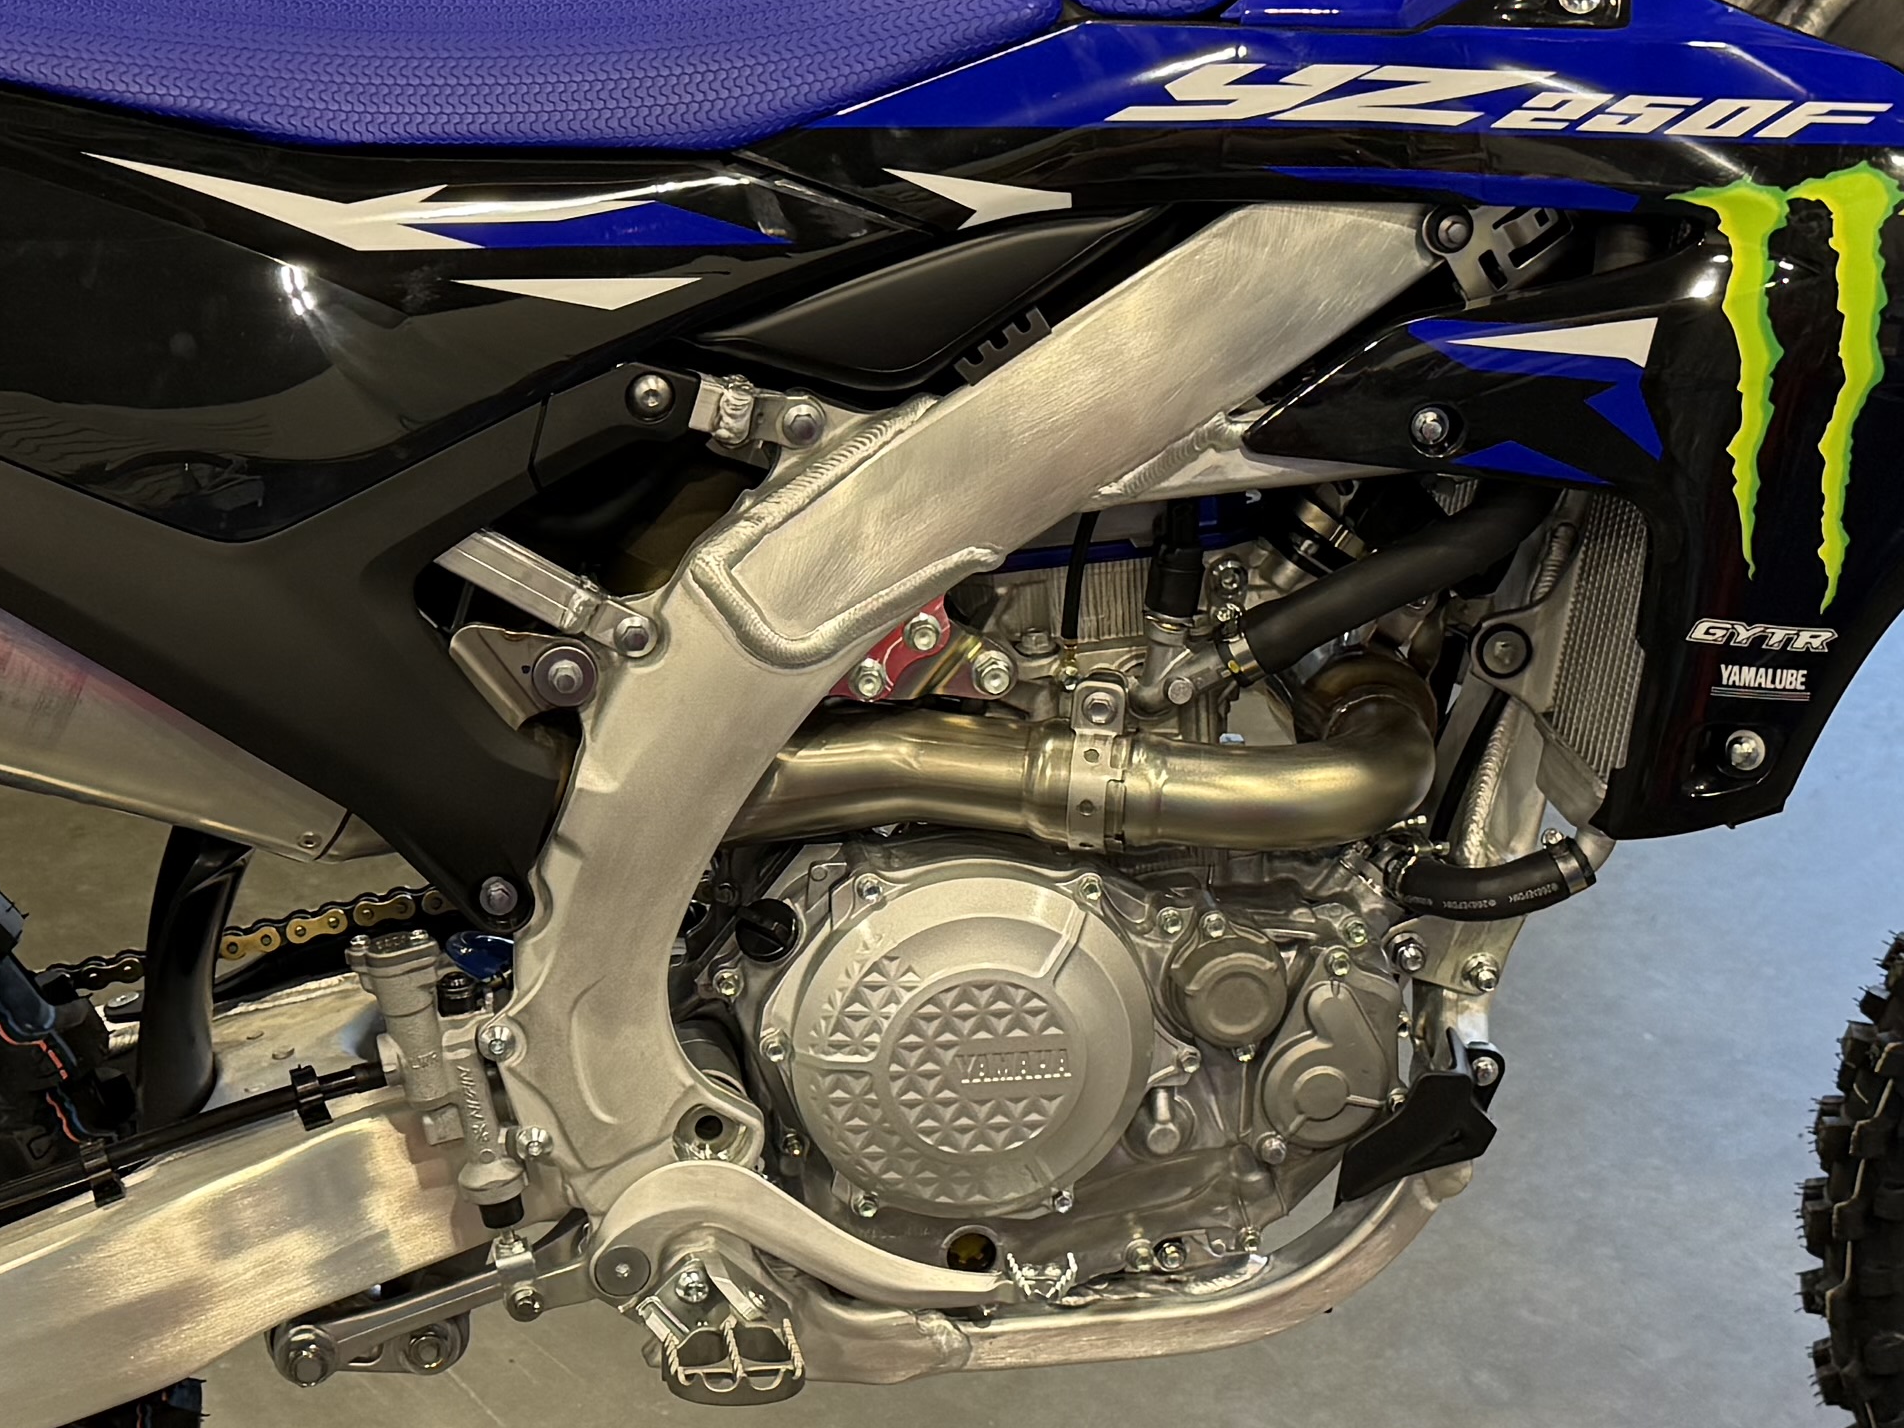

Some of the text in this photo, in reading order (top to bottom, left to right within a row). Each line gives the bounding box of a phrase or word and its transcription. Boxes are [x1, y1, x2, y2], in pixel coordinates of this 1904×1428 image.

[1102, 62, 1894, 140] YZ 250F
[1685, 617, 1840, 653] GYTR
[1720, 663, 1808, 691] YAMALUBE
[954, 1048, 1074, 1086] YAMAHA
